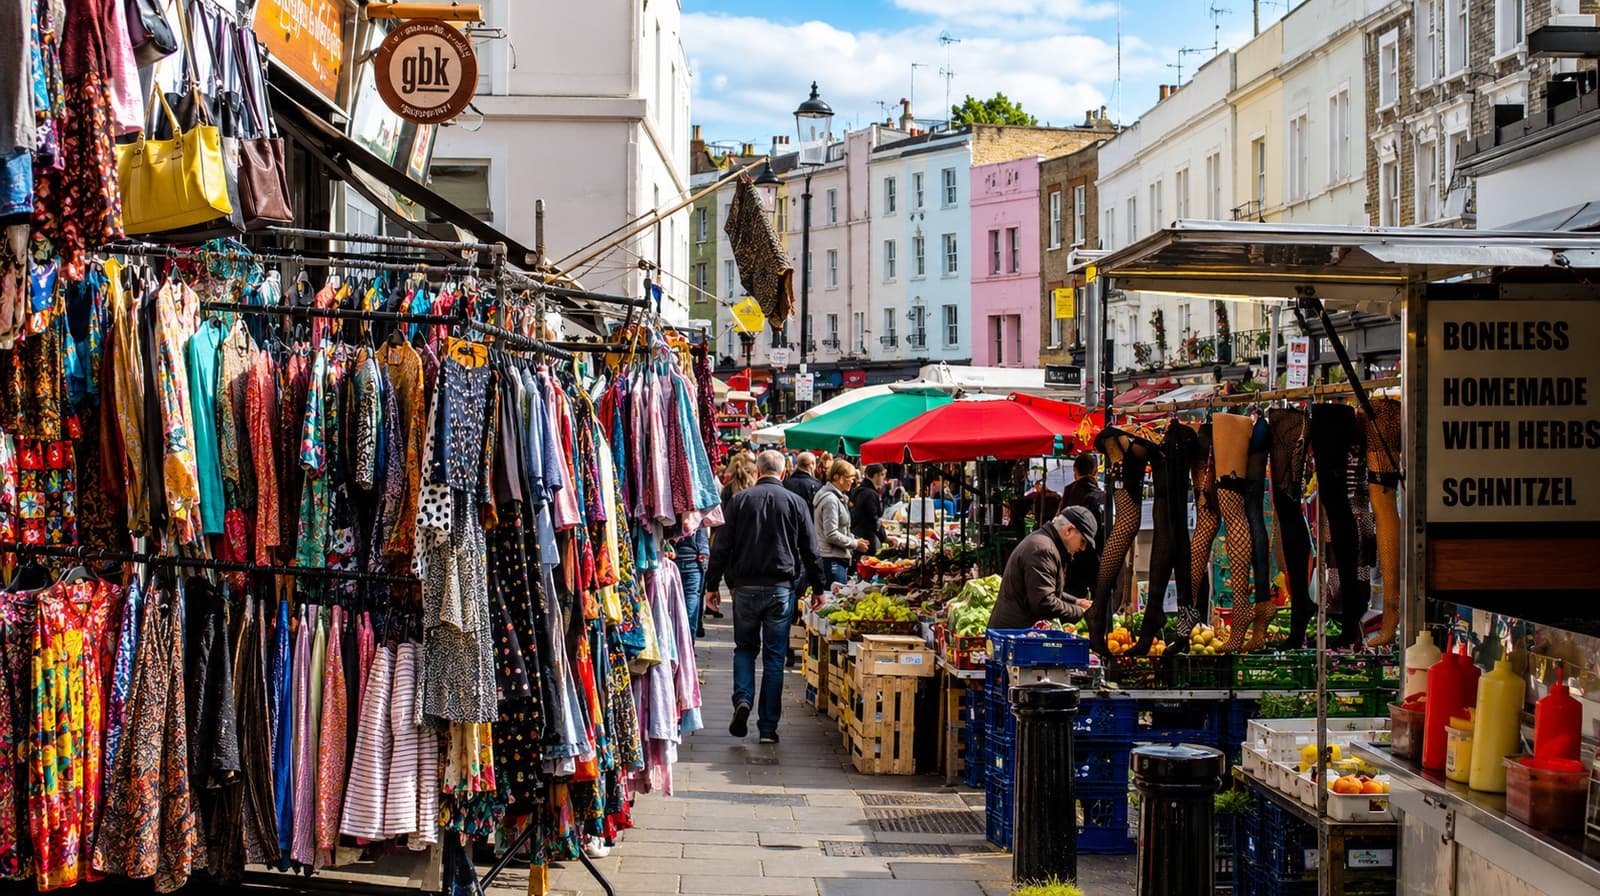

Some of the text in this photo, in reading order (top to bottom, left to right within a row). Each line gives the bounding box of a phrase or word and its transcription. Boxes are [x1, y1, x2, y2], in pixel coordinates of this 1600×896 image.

[402, 47, 450, 94] gbk
[1443, 321, 1569, 351] BONELESS
[1443, 377, 1587, 406] HOMEMADE
[1442, 420, 1600, 449] WITH HERBS
[1442, 477, 1576, 507] SCHNITZEL
